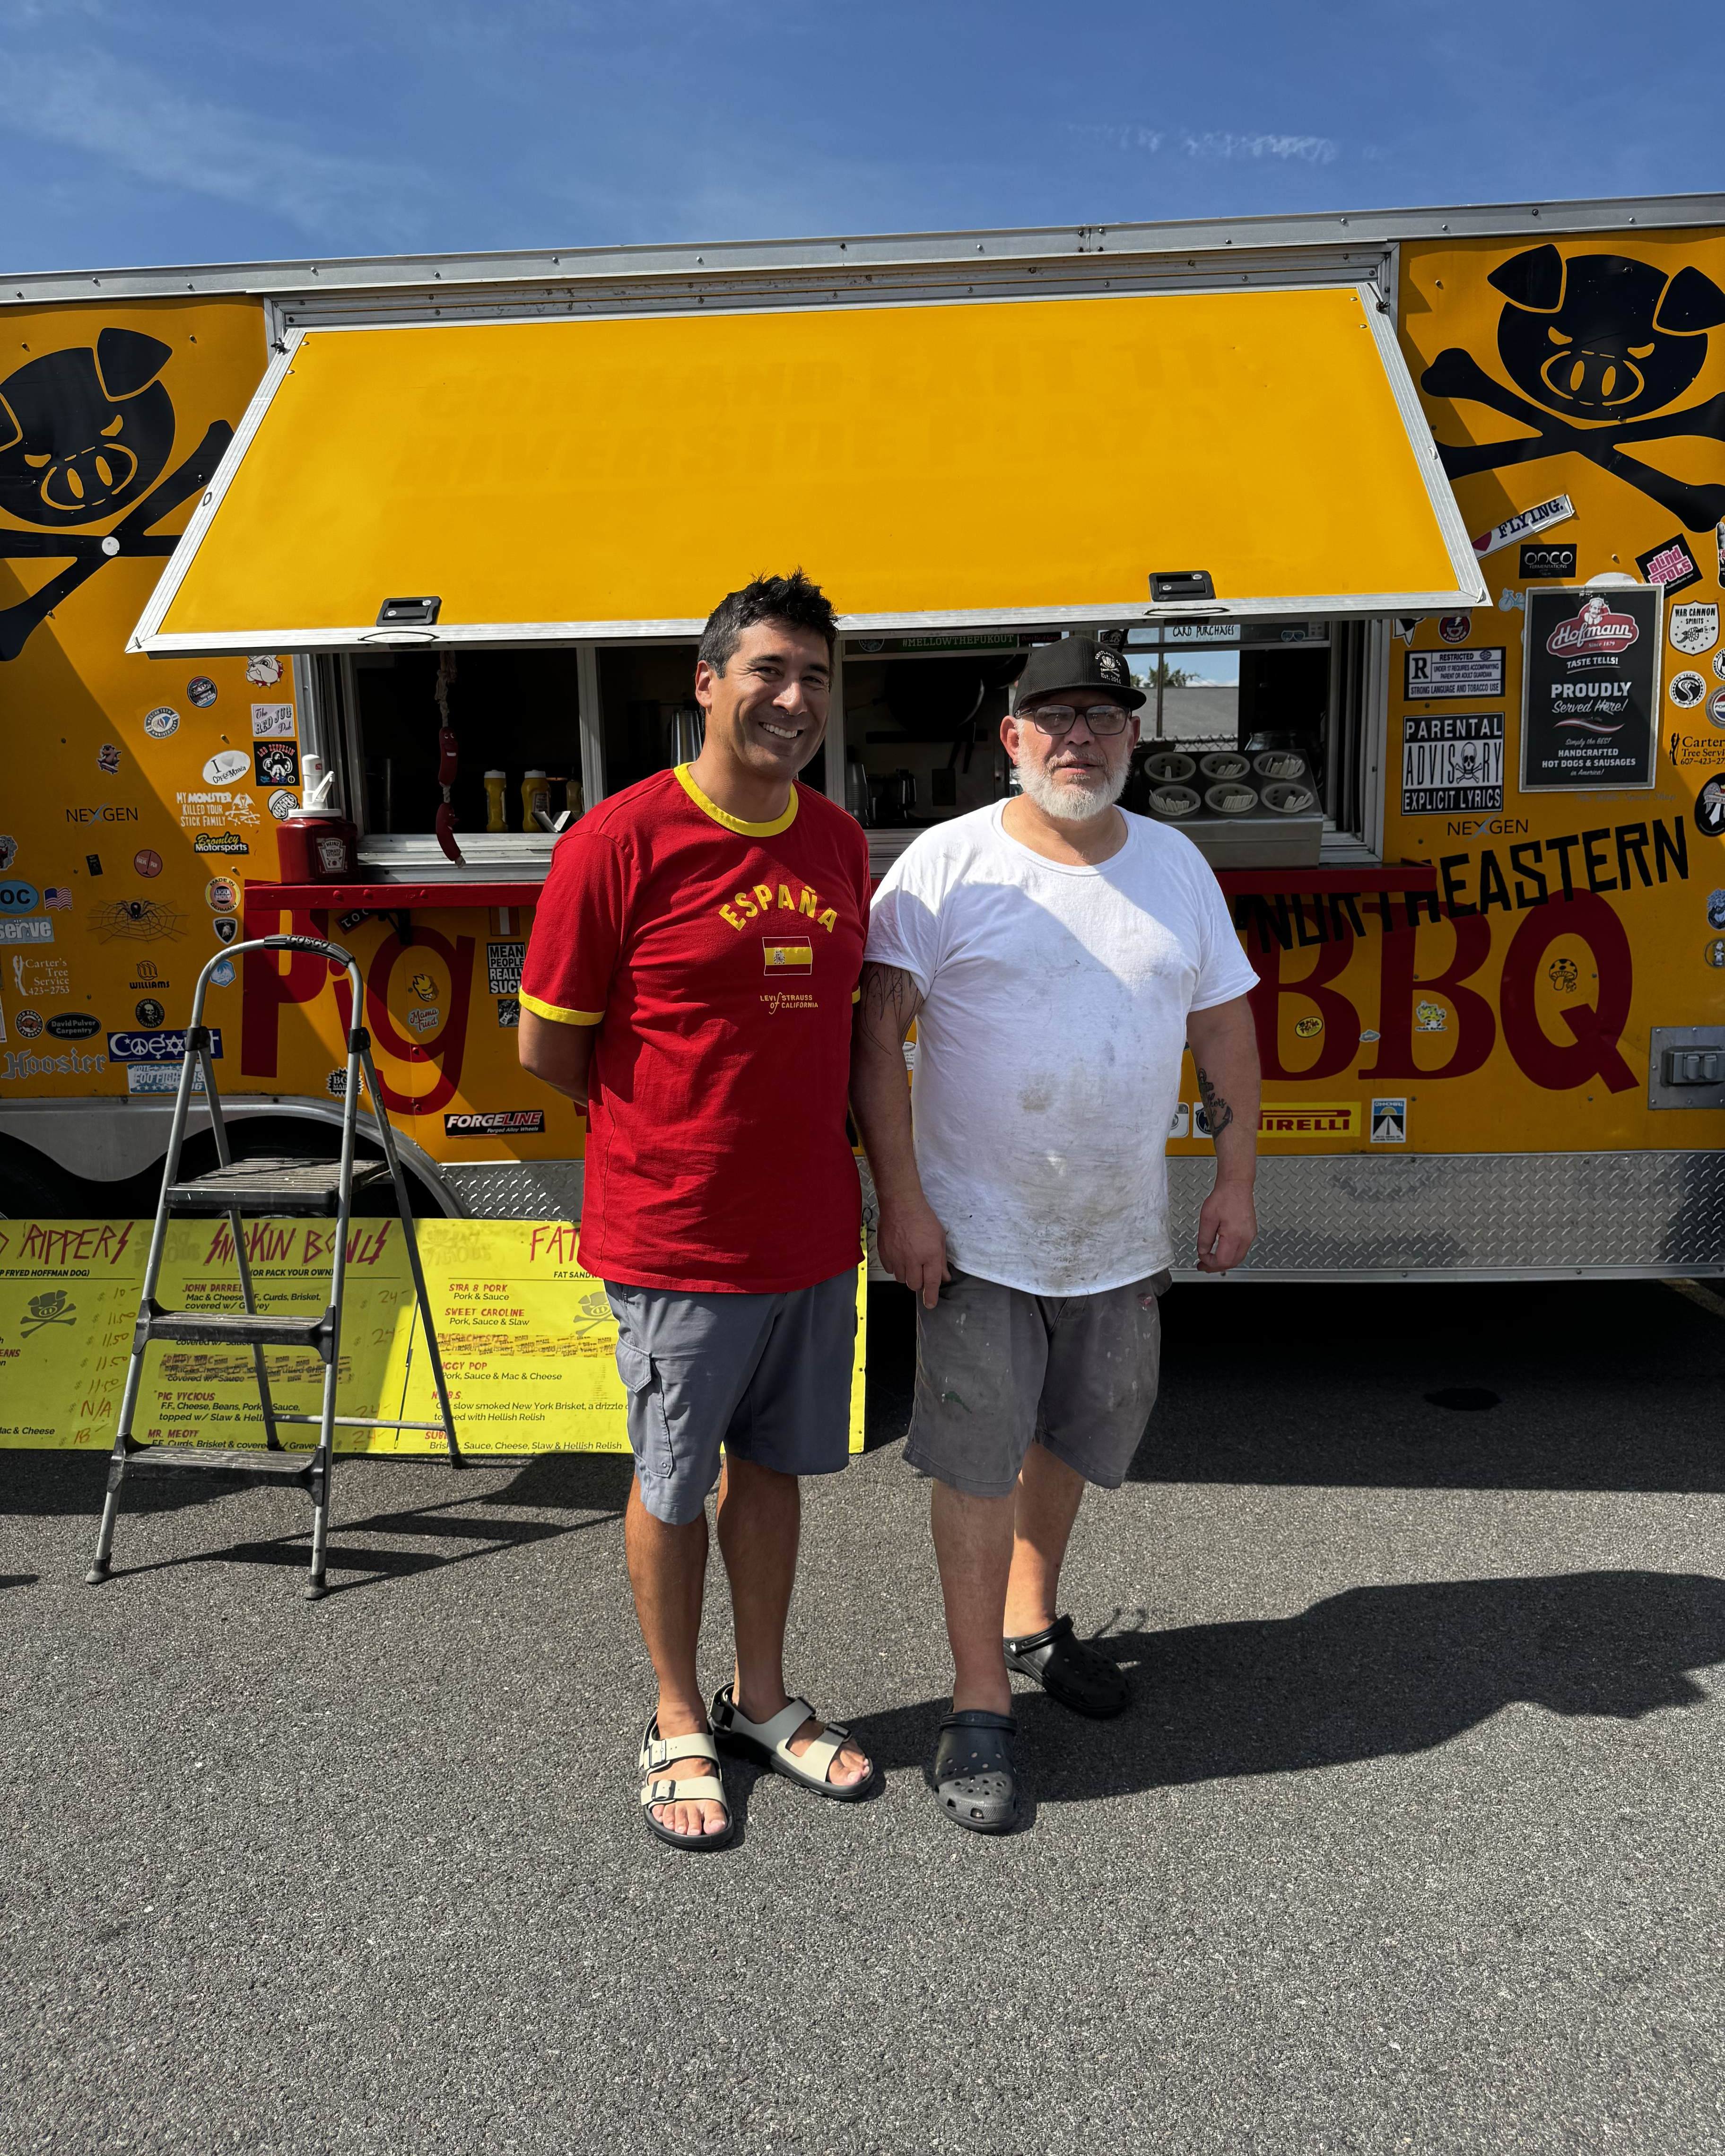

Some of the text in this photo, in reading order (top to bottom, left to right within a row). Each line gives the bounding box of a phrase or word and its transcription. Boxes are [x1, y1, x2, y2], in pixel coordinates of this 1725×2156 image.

[1675, 608, 1715, 617] WAR CANNON
[1173, 625, 1234, 638] CARD PURCHASES
[1552, 623, 1632, 649] Hofmann
[902, 635, 1014, 647] #MELLOWTHEFUKOUT
[1440, 653, 1473, 661] RESTRICTED
[1411, 658, 1429, 679] R
[1567, 658, 1591, 669] TASTE
[1411, 687, 1429, 695] STRONG
[1431, 685, 1455, 694] LANGUAGE
[1490, 683, 1499, 691] USE
[1551, 682, 1631, 698] PROUDLY
[1552, 699, 1628, 715] Served Here!
[255, 708, 268, 719] The
[255, 707, 292, 734] RED JUG
[278, 722, 292, 735] Pub
[1406, 718, 1502, 739] PARENTAL
[257, 744, 296, 757] LED ZEPPELIN
[211, 759, 221, 774] I
[1405, 742, 1501, 786] ADVISRY
[177, 792, 232, 803] MY MONSTER
[1404, 789, 1500, 810] EXPLICIT LYRICS
[66, 807, 138, 823] NEXGEN
[183, 805, 223, 815] KILLED YOUR
[181, 816, 226, 826] STICK FAMILY
[1447, 819, 1528, 835] NEXGEN
[197, 833, 239, 847] Bromley
[195, 843, 247, 852] Motorsports
[210, 878, 227, 887] MADE
[210, 902, 237, 912] GERMANY
[718, 884, 837, 933] ESPAÑA
[289, 935, 330, 949] COSCO
[490, 946, 524, 957] MEAN
[25, 958, 67, 968] Carter's
[490, 958, 525, 967] PEOPLE
[45, 968, 68, 976] Tree
[34, 977, 70, 986] Service
[129, 981, 170, 989] WILLIAMS
[1246, 887, 1640, 1094] BBQ
[410, 1008, 438, 1023] Mama
[417, 1018, 437, 1031] Tried
[1, 1047, 107, 1079] Hoosier
[447, 1112, 542, 1129] FORGELINE
[17, 1222, 134, 1264] RIPPERS
[291, 1293, 321, 1301] Brisket,
[469, 1362, 488, 1370] POP
[158, 1392, 216, 1401] PIG VYCIOUS
[81, 1398, 112, 1421] N/A
[177, 1402, 240, 1411] Cheese, Beans,
[476, 1402, 510, 1410] smoked
[556, 1402, 587, 1411] Brisket,
[595, 1402, 623, 1410] drizzle
[159, 1414, 192, 1422] topped
[168, 1429, 200, 1438] MEOFF
[464, 1442, 622, 1450] Sauce, Cheese, Slaw Hellish Relish
